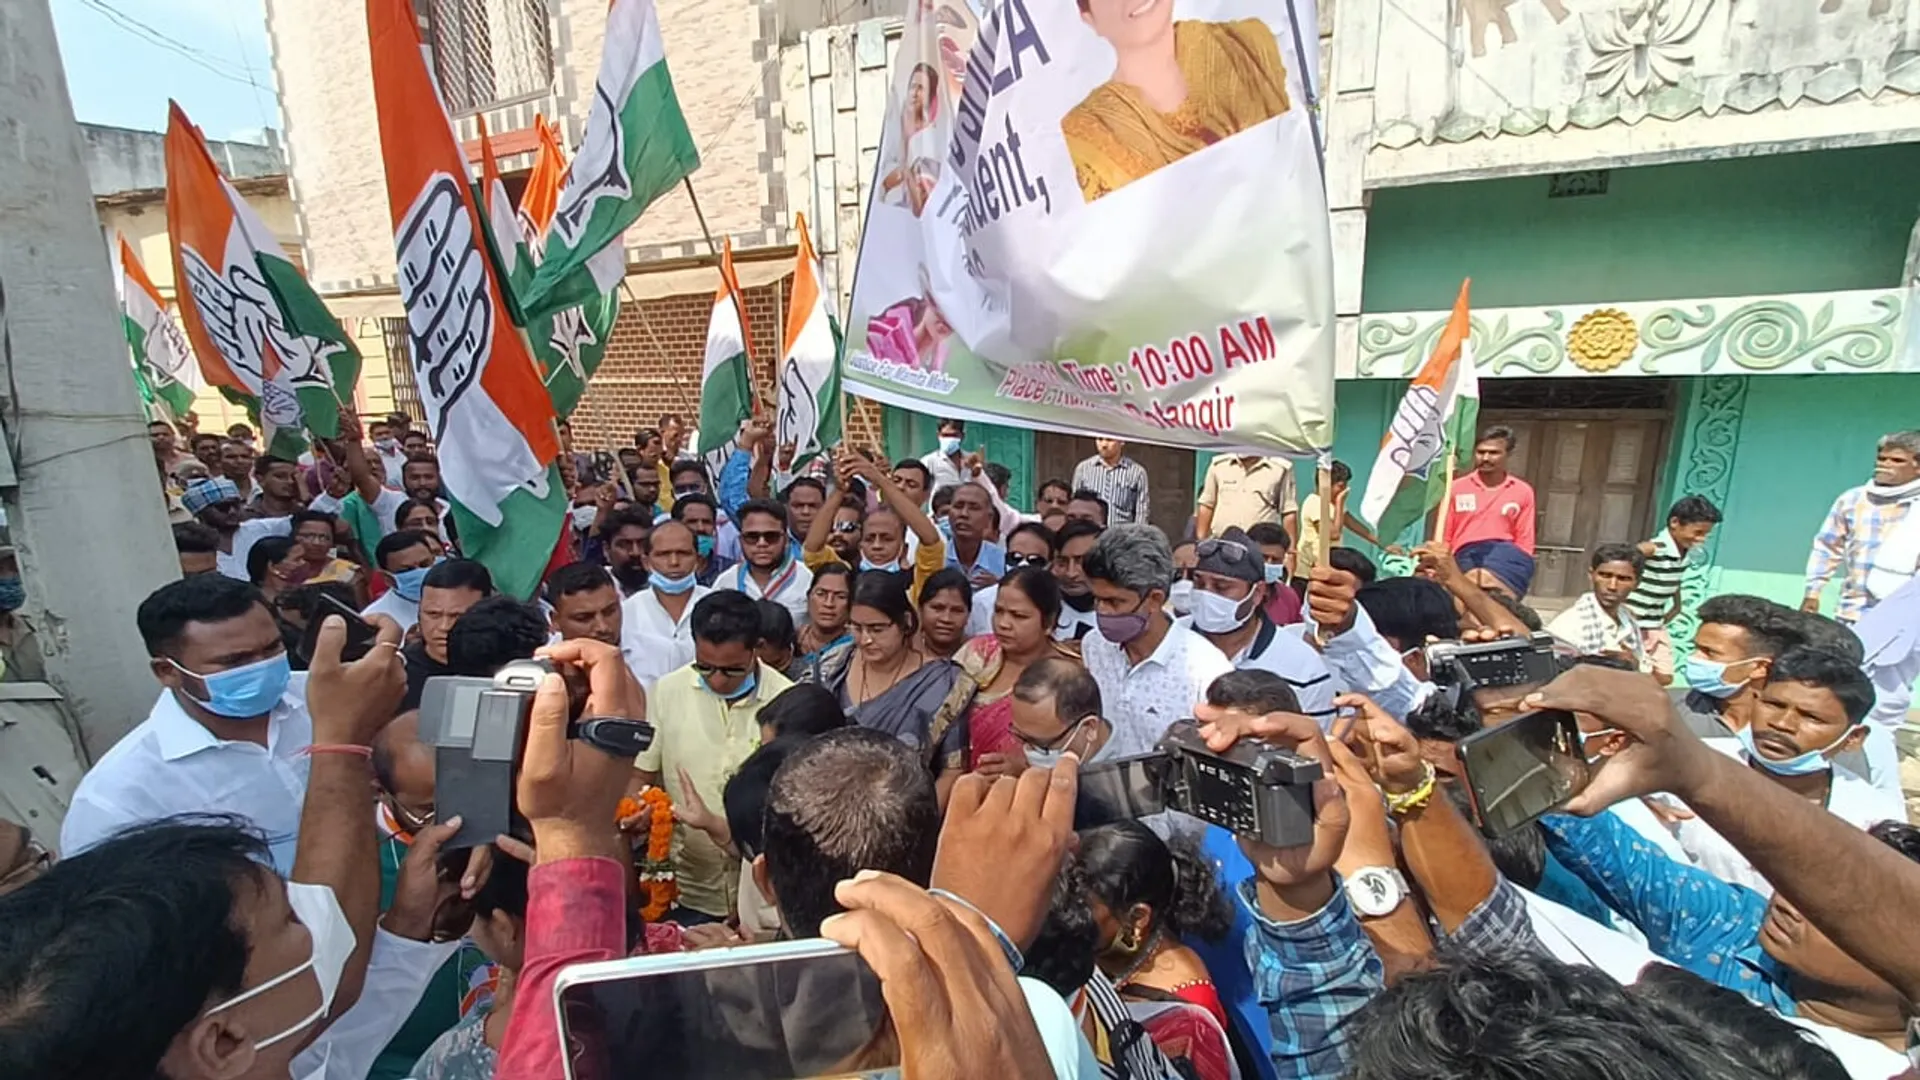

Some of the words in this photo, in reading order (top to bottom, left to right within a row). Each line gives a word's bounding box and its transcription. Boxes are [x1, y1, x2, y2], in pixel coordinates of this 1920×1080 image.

[1062, 361, 1118, 394] Time
[1131, 335, 1214, 389] 10:00
[1219, 316, 1277, 370] AM
